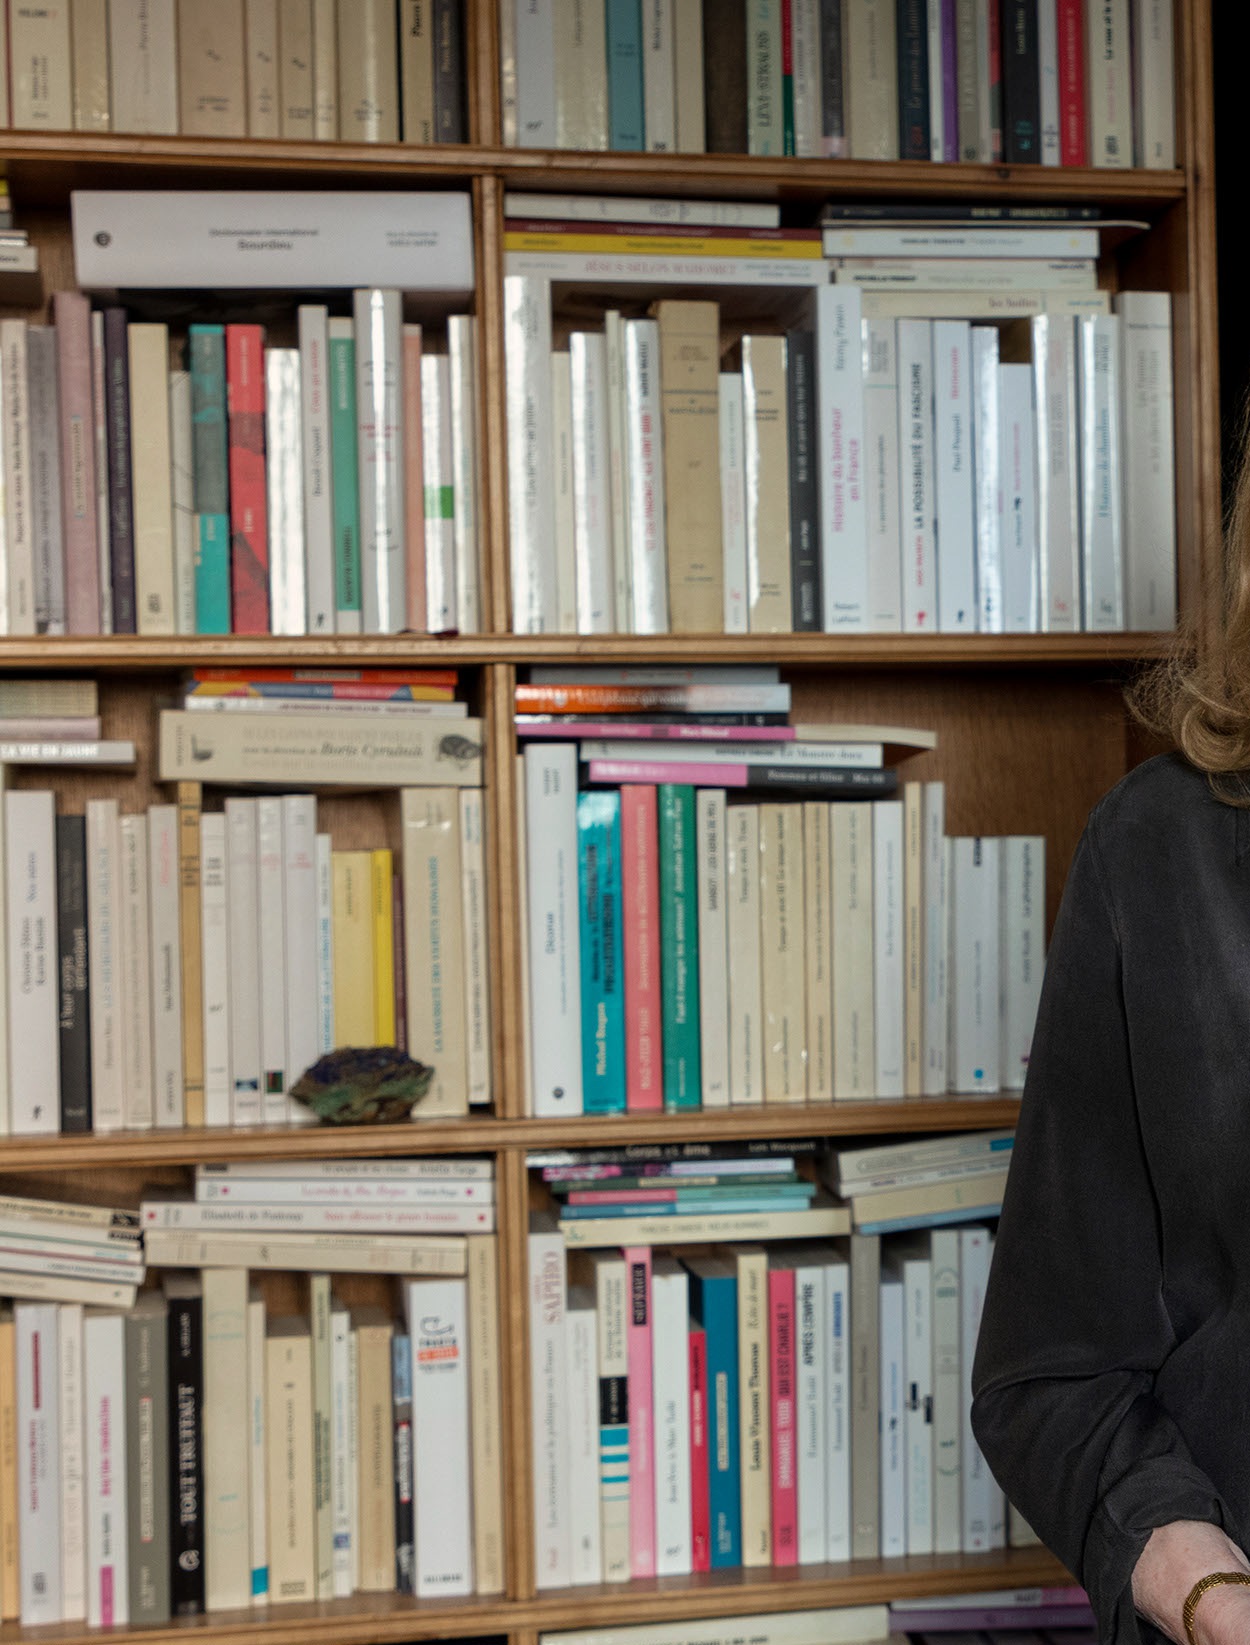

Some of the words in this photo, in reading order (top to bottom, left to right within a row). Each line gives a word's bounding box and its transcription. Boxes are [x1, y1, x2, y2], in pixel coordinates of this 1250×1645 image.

[238, 239, 293, 252] Bourdieu
[910, 363, 922, 419] FASCISME
[830, 408, 842, 460] bonheur
[912, 422, 922, 439] DU
[831, 462, 843, 477] du
[847, 438, 859, 483] France
[910, 443, 923, 513] POSSIBILITÉ
[832, 481, 844, 532] Histoire
[848, 486, 860, 501] en
[913, 516, 924, 529] LA
[672, 852, 684, 892] Jonathan
[62, 955, 75, 991] corps
[675, 957, 688, 992] manger
[595, 1002, 608, 1038] Ragon
[596, 1042, 607, 1076] Michel
[626, 1145, 661, 1158] Corps
[543, 1251, 562, 1324] SAPIRO
[776, 1311, 791, 1355] CHARLIE
[801, 1329, 815, 1366] APRÈS
[748, 1343, 760, 1387] Thomas
[777, 1357, 791, 1376] EST
[778, 1378, 792, 1396] QUI
[806, 1376, 817, 1400] Todd
[832, 1382, 843, 1406] Todd
[178, 1383, 197, 1471] TRUFFAUT
[778, 1400, 792, 1427] TODD
[806, 1402, 818, 1458] Emmanuel
[832, 1408, 844, 1452] Emmanuel
[749, 1440, 762, 1471] Louis
[778, 1430, 793, 1488] EMMANUEL
[179, 1476, 198, 1525] TOUT
